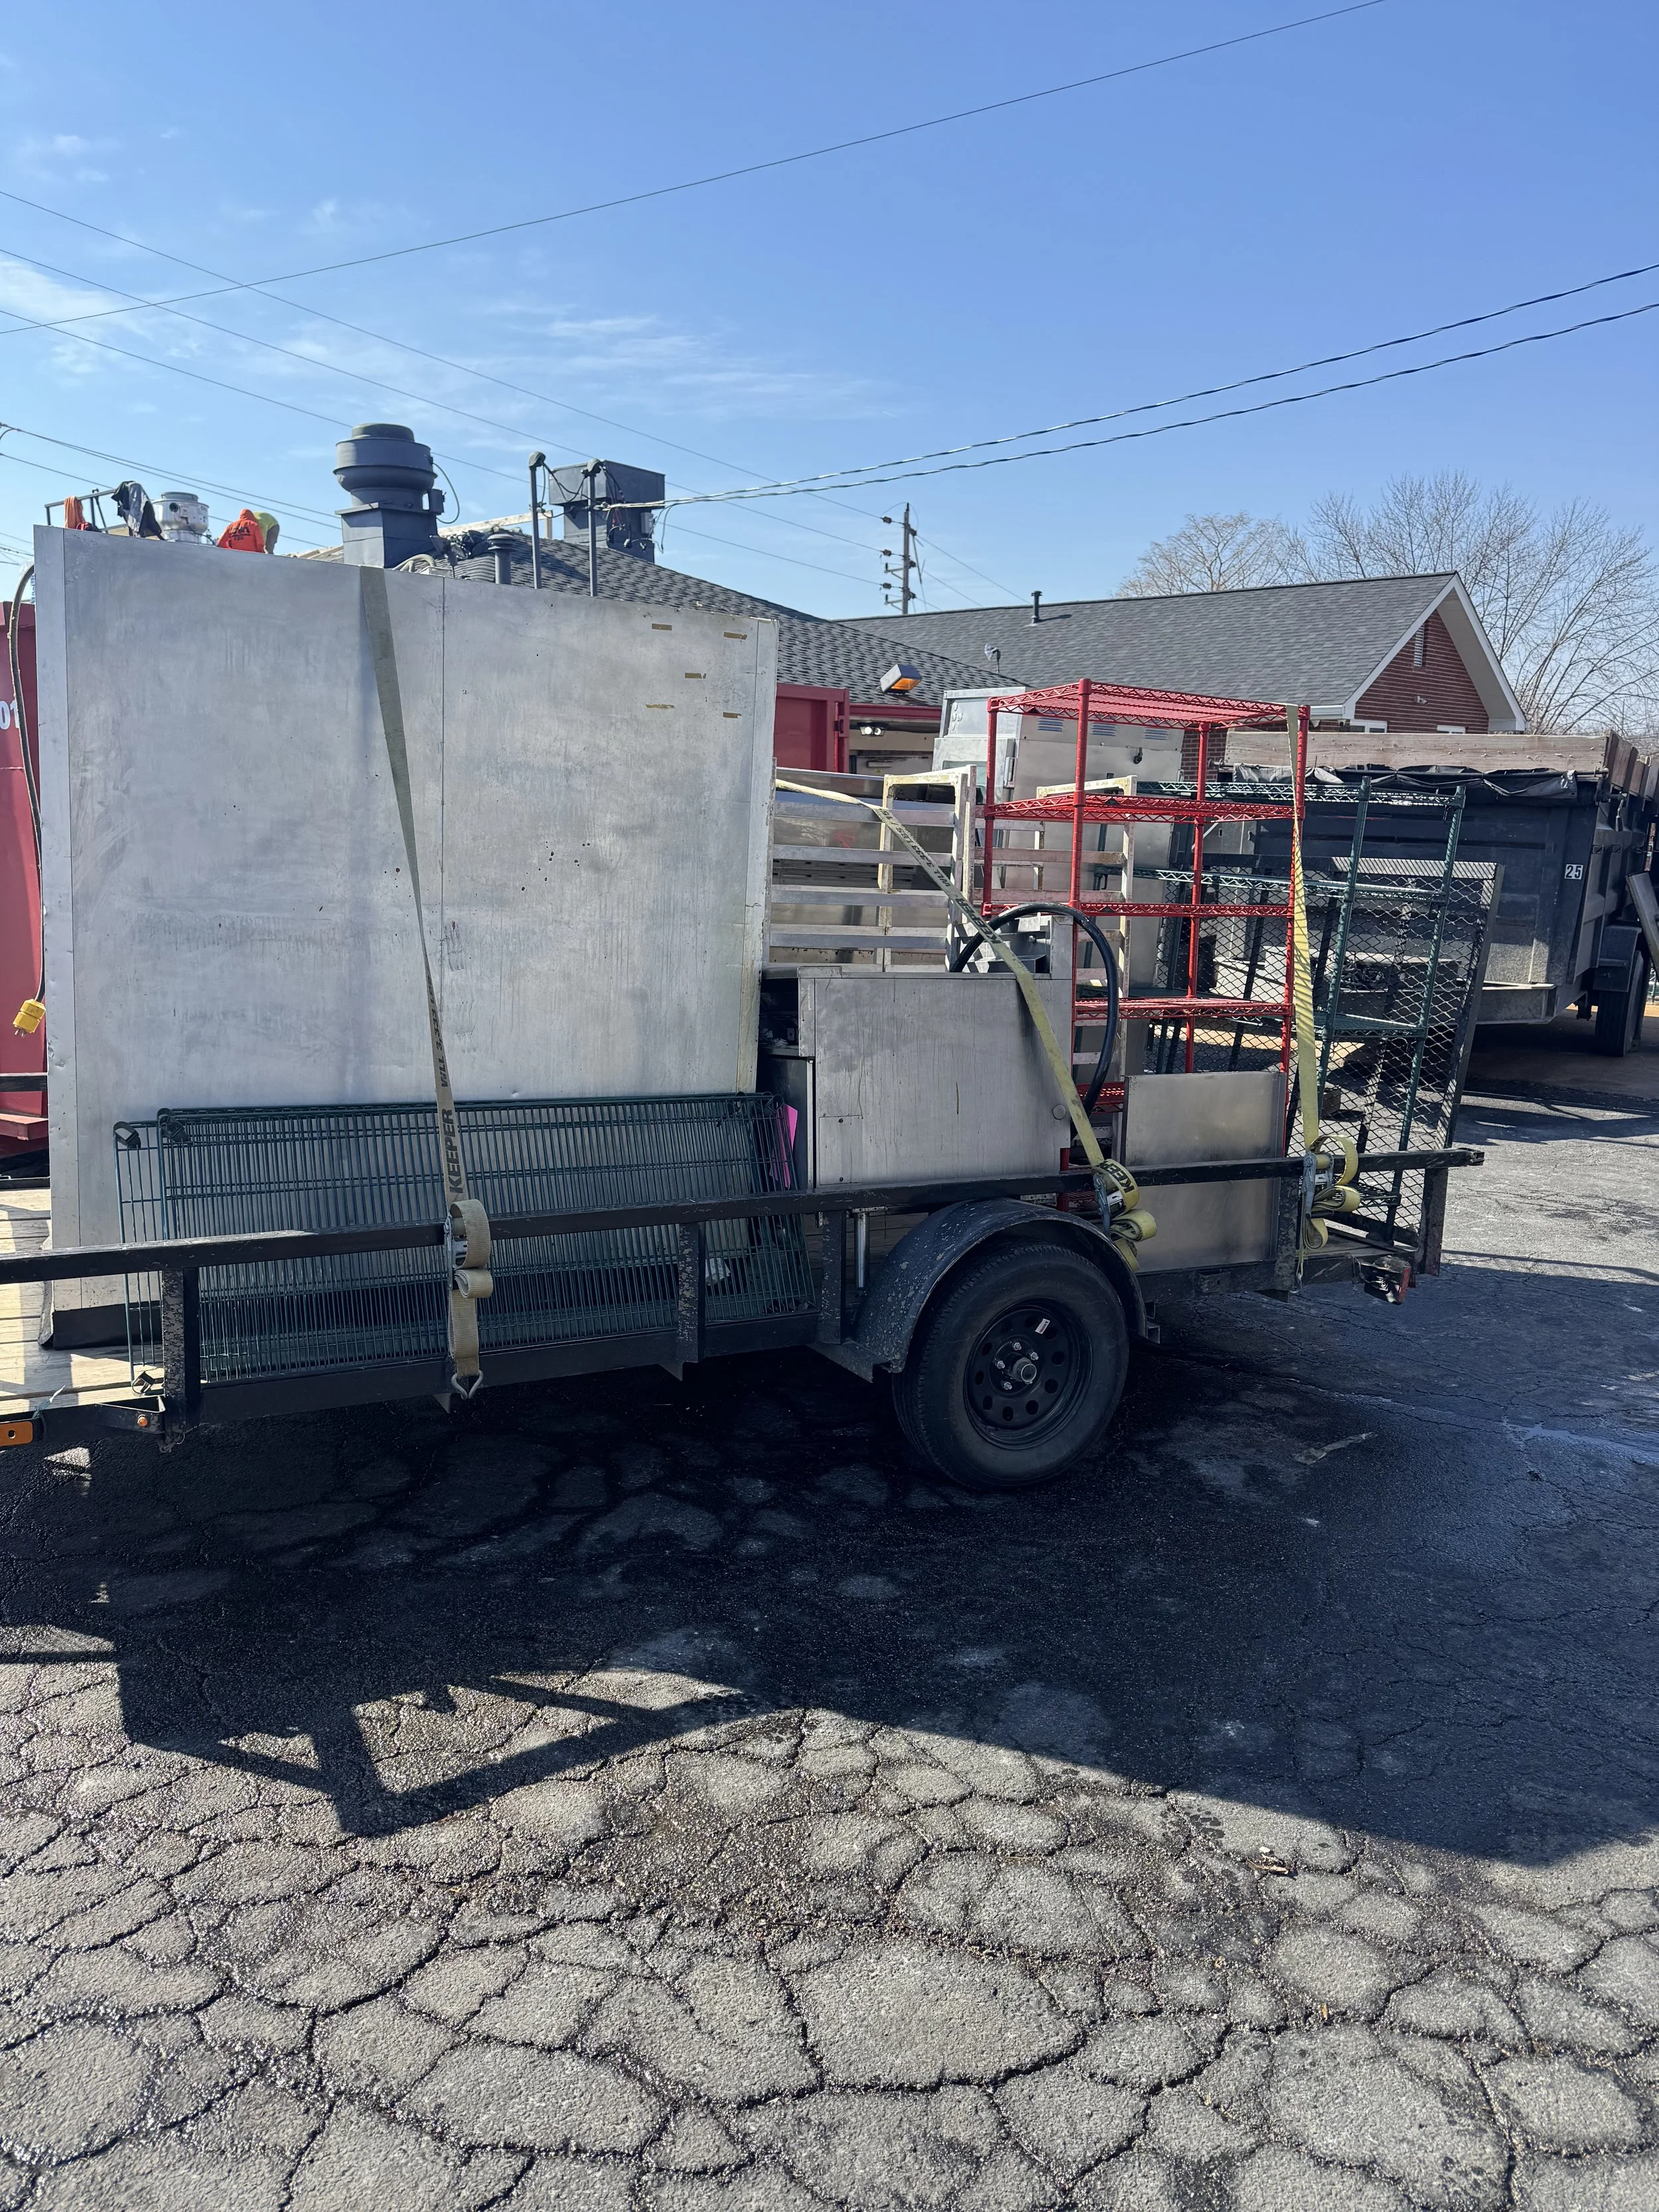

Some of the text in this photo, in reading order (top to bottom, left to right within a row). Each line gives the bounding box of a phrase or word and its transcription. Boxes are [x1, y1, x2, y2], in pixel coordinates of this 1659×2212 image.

[911, 845, 935, 868] 3,333
[1565, 865, 1581, 879] 25
[934, 869, 952, 887] WLL
[956, 897, 1002, 944] KEEPER
[431, 1008, 443, 1051] 3,333
[438, 1056, 449, 1087] WLL
[442, 1108, 463, 1194] KEEPER
